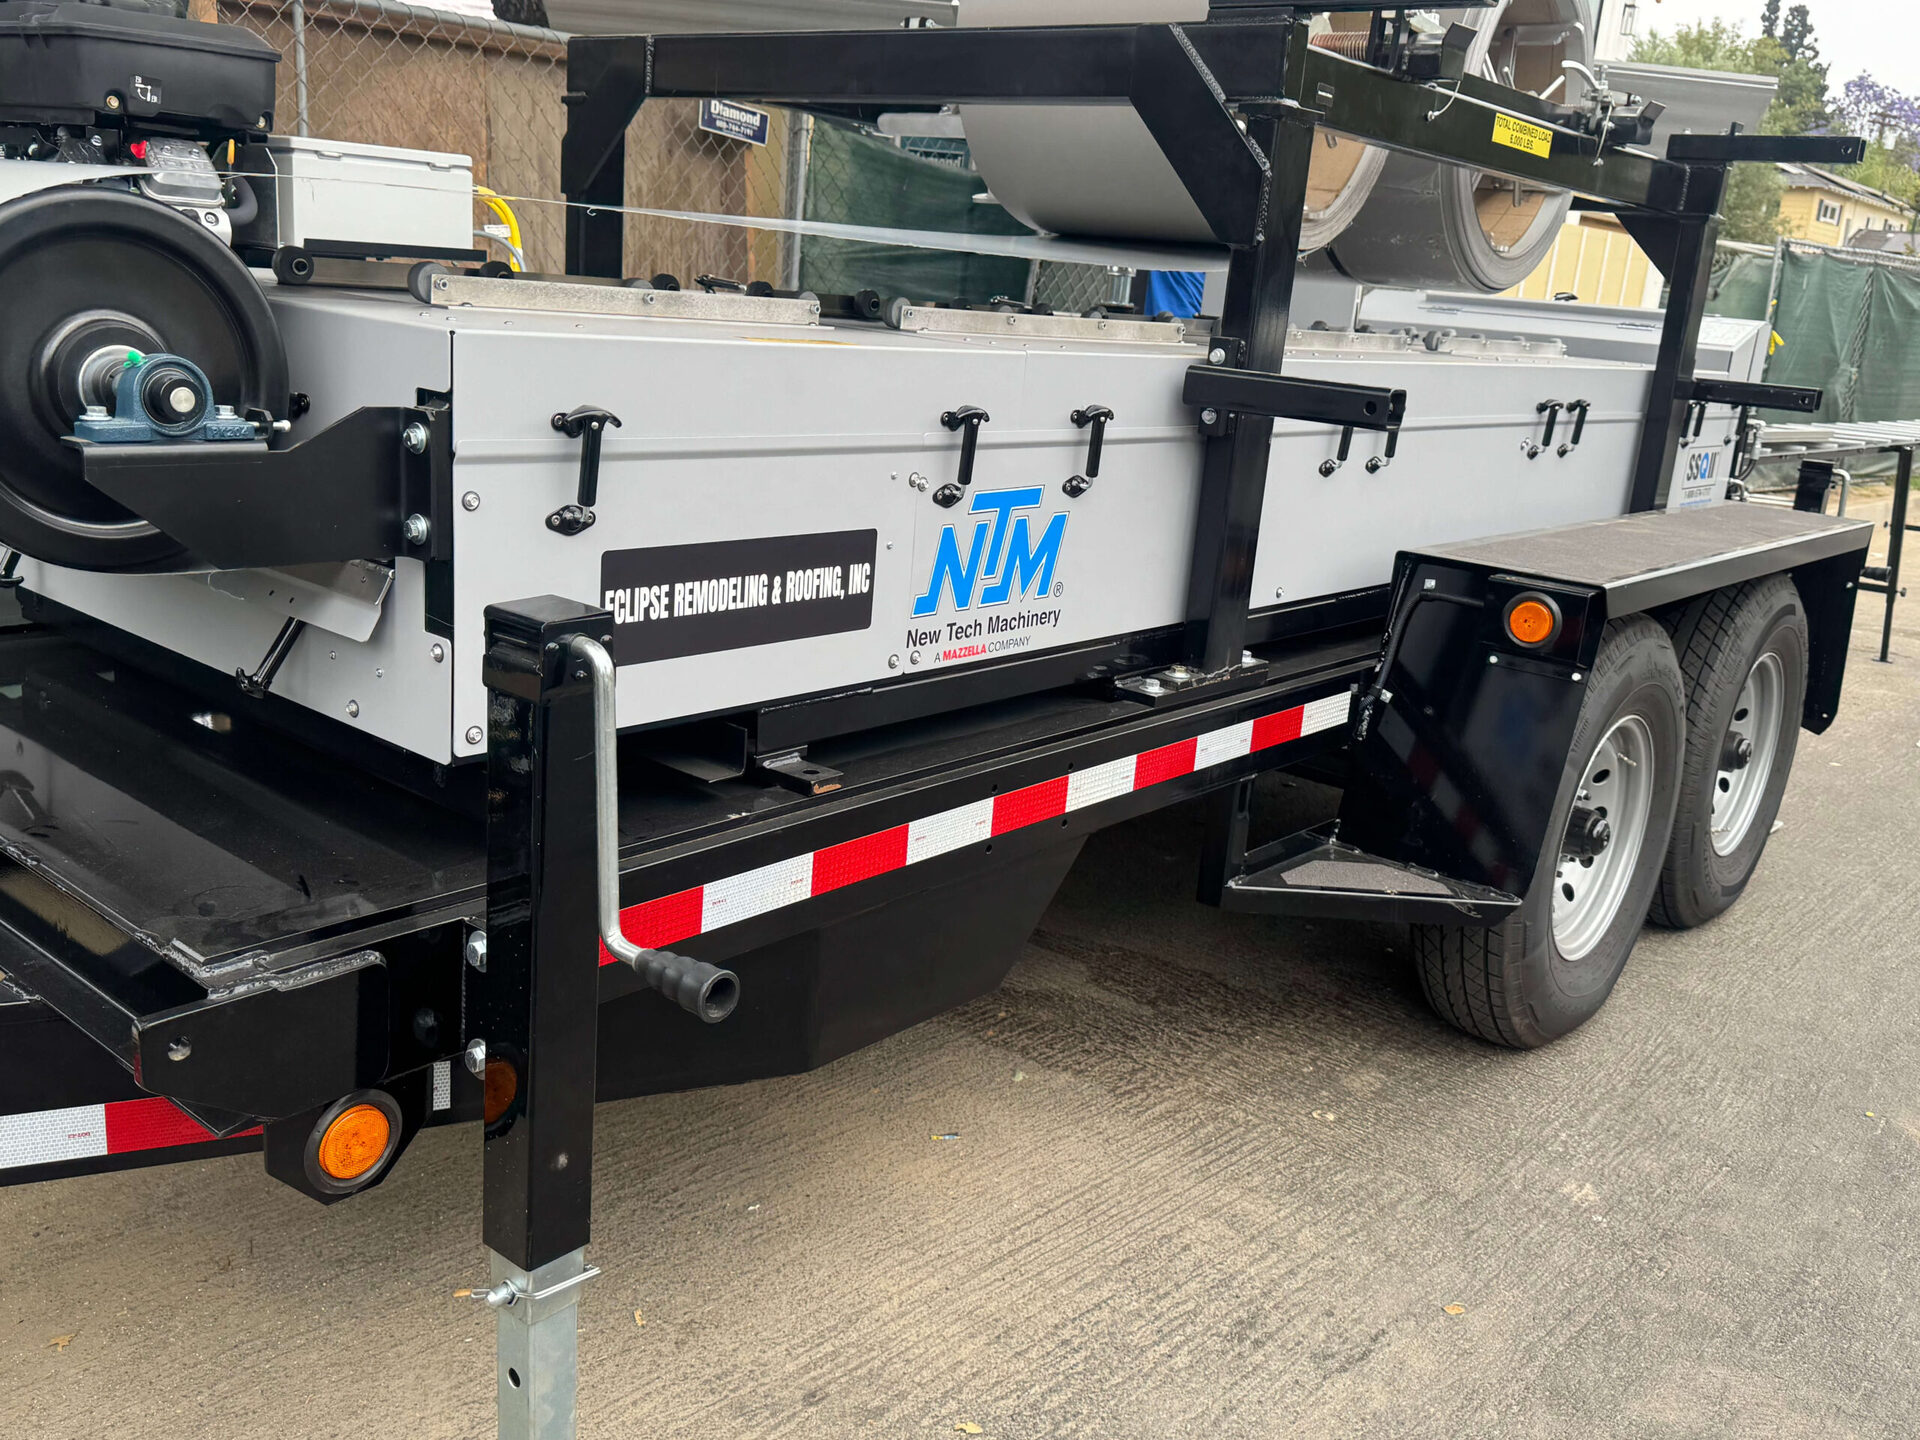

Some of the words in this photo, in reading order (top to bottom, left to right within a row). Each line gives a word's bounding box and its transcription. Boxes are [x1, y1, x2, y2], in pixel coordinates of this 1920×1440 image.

[711, 100, 760, 126] Diamond
[1496, 116, 1511, 130] TOTAL
[1512, 121, 1538, 139] COMBINED
[1538, 131, 1551, 143] LOAD
[605, 584, 669, 625] ECLIPSE
[673, 573, 769, 617] REMODELING
[771, 575, 782, 605] &
[785, 565, 844, 602] ROOFING,
[848, 562, 871, 595] INC
[906, 628, 941, 648] New
[946, 619, 982, 641] Tech
[987, 609, 1061, 635] Machinery
[934, 653, 941, 663] A
[942, 644, 986, 662] MAZZELLA
[988, 635, 1031, 653] COMPANY
